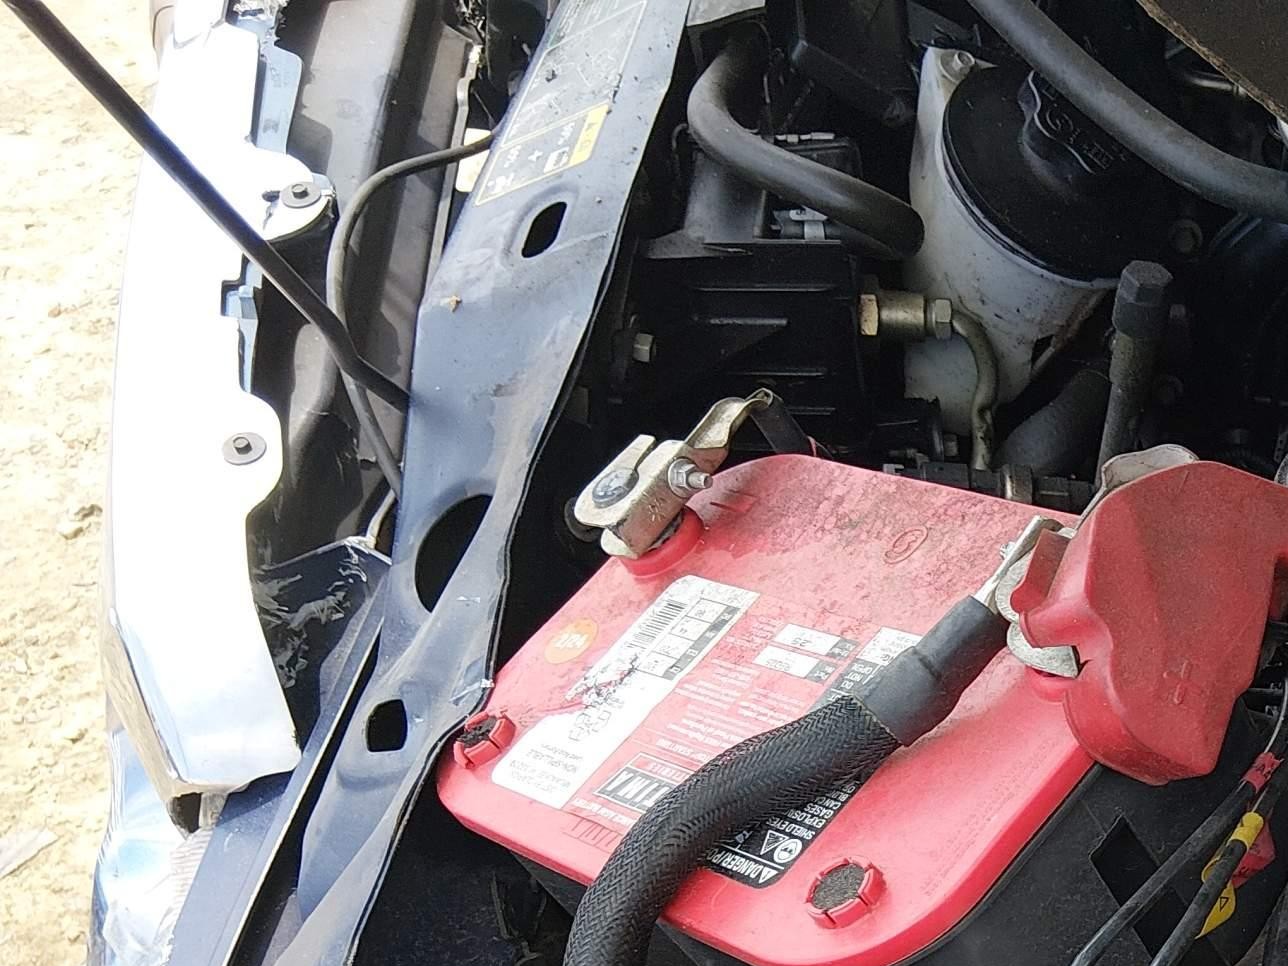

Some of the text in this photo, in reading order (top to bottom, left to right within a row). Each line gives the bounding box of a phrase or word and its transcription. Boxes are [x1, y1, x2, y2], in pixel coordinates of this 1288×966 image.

[844, 669, 864, 682] NOT
[605, 769, 671, 809] TIMA
[802, 801, 835, 819] GASES
[764, 815, 816, 841] SHIELD EYES
